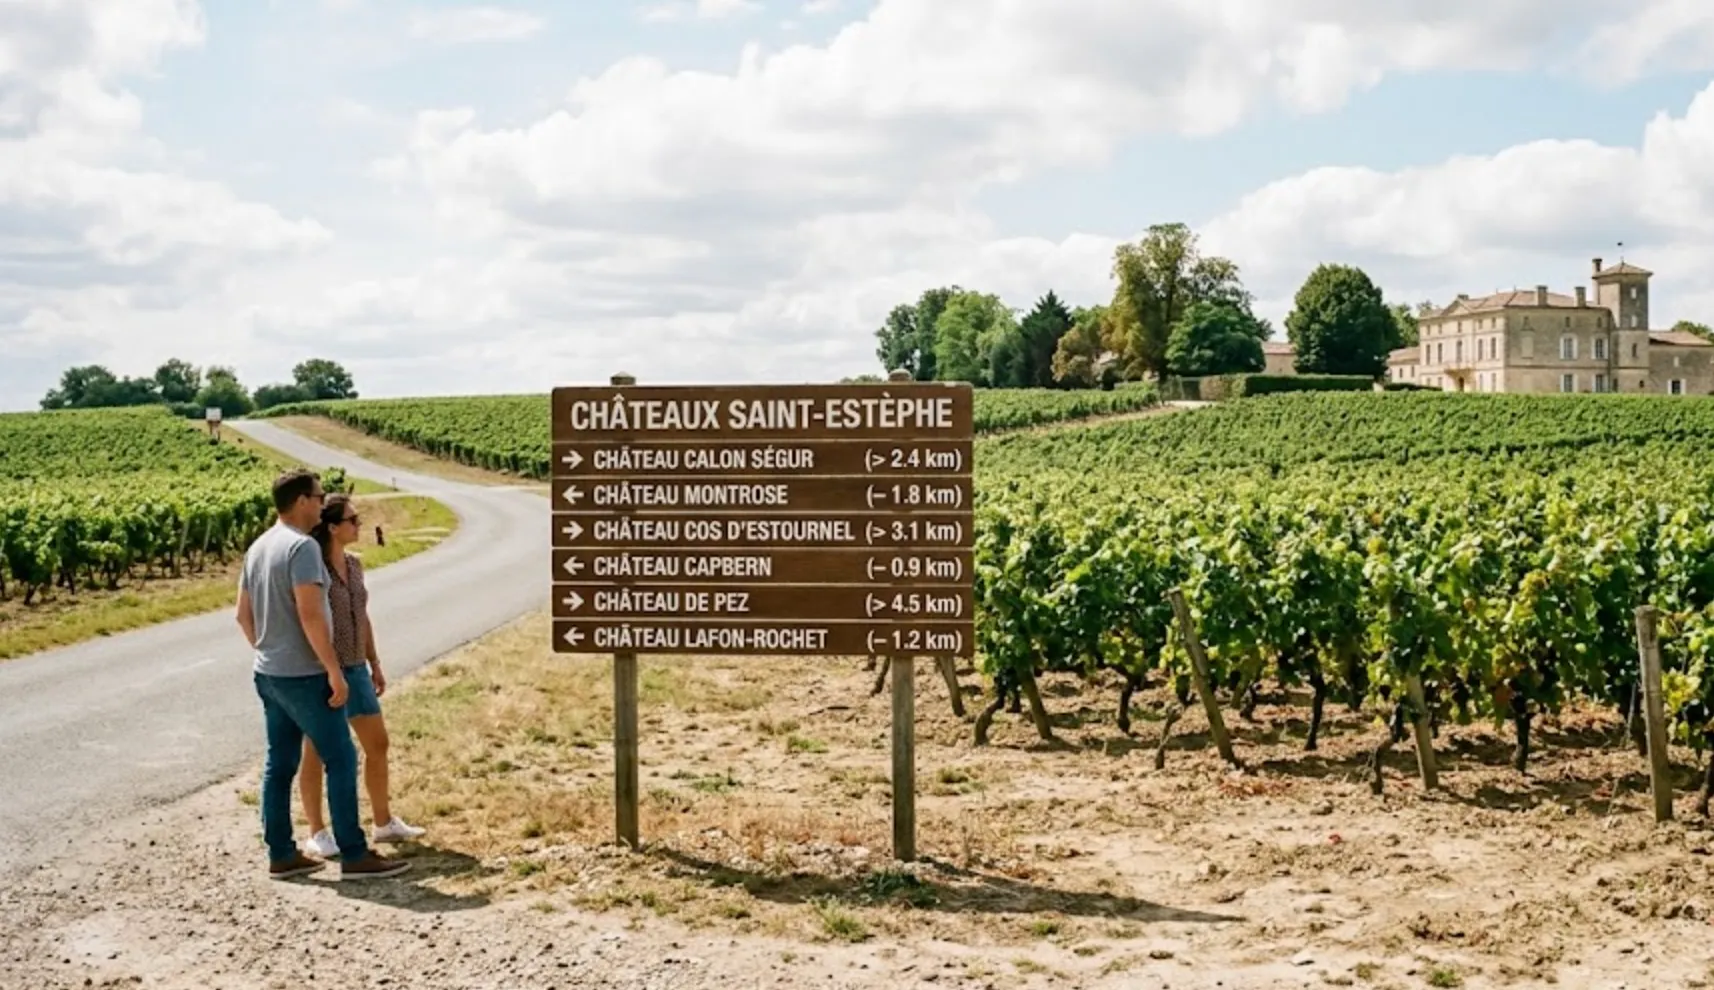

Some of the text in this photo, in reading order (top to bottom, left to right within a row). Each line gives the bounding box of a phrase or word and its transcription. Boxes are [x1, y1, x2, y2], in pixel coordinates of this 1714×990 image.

[572, 391, 953, 430] CHÂTEAUX SAINT-ESTÈPHE
[594, 446, 678, 469] CHÂTEAU
[685, 449, 745, 469] CALON
[752, 445, 814, 469] SÉGUR
[891, 448, 920, 468] 2.4
[926, 448, 962, 472] km)
[594, 481, 678, 505] CHÂTEAU
[685, 485, 788, 504] MONTROSE
[892, 484, 920, 504] 1.8
[926, 484, 962, 508] km)
[594, 516, 678, 540] CHÂTEAU
[685, 520, 722, 540] COS
[728, 520, 855, 540] D'ESTOURNEL
[891, 521, 918, 540] 3.1
[926, 521, 962, 545] km)
[594, 552, 678, 576] CHÂTEAU
[685, 556, 772, 577] CAPBERN
[891, 556, 920, 577] 0.9
[926, 556, 962, 580] km)
[594, 588, 679, 612] CHÂTEAU
[685, 592, 709, 612] DE
[715, 592, 749, 612] PEZ
[891, 593, 920, 613] 4.5
[926, 593, 962, 617] km)
[594, 623, 679, 648] CHÂTEAU
[685, 628, 828, 649] LAFON-ROCHET
[892, 630, 920, 650] 1.2
[926, 629, 962, 652] km)
